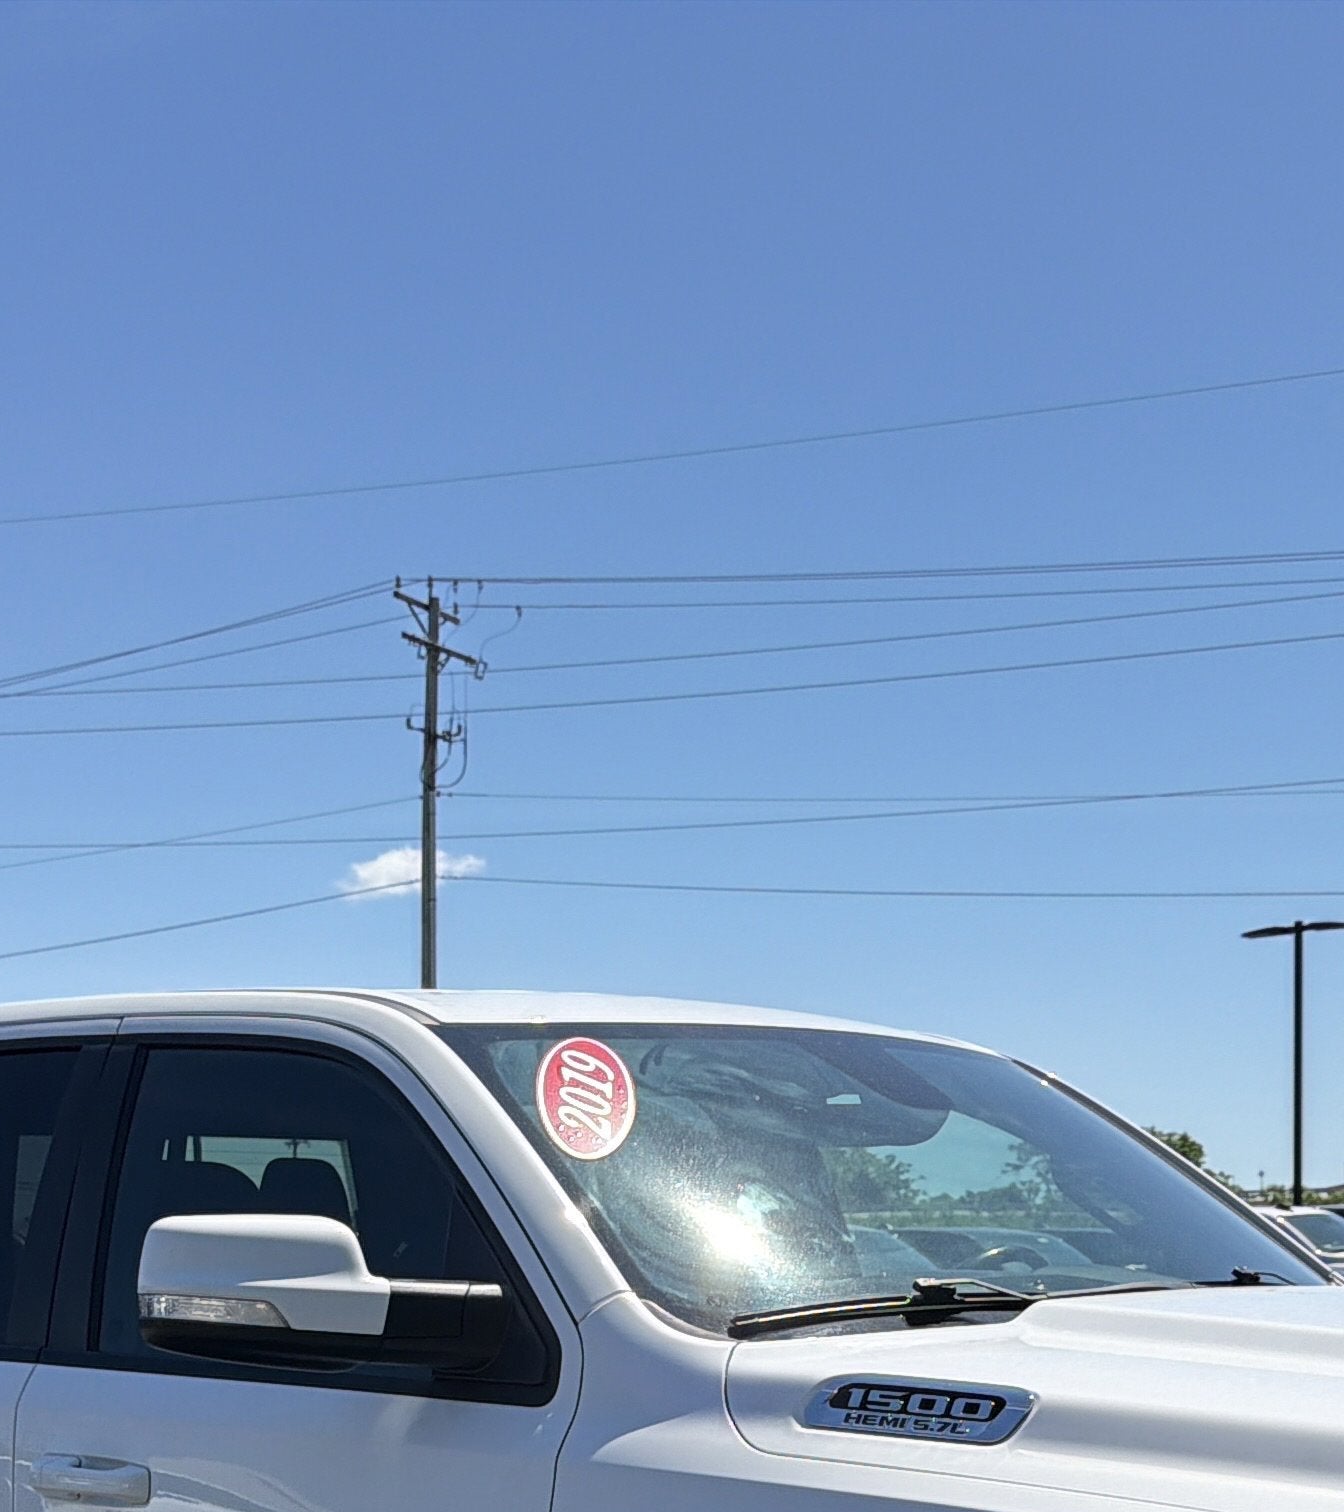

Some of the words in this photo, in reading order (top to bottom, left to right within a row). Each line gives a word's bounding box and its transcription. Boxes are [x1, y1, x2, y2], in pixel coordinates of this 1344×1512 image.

[558, 1049, 615, 1142] 2019
[846, 1388, 992, 1420] 1500
[843, 1412, 906, 1429] HEMI
[913, 1418, 969, 1435] 5.7L
